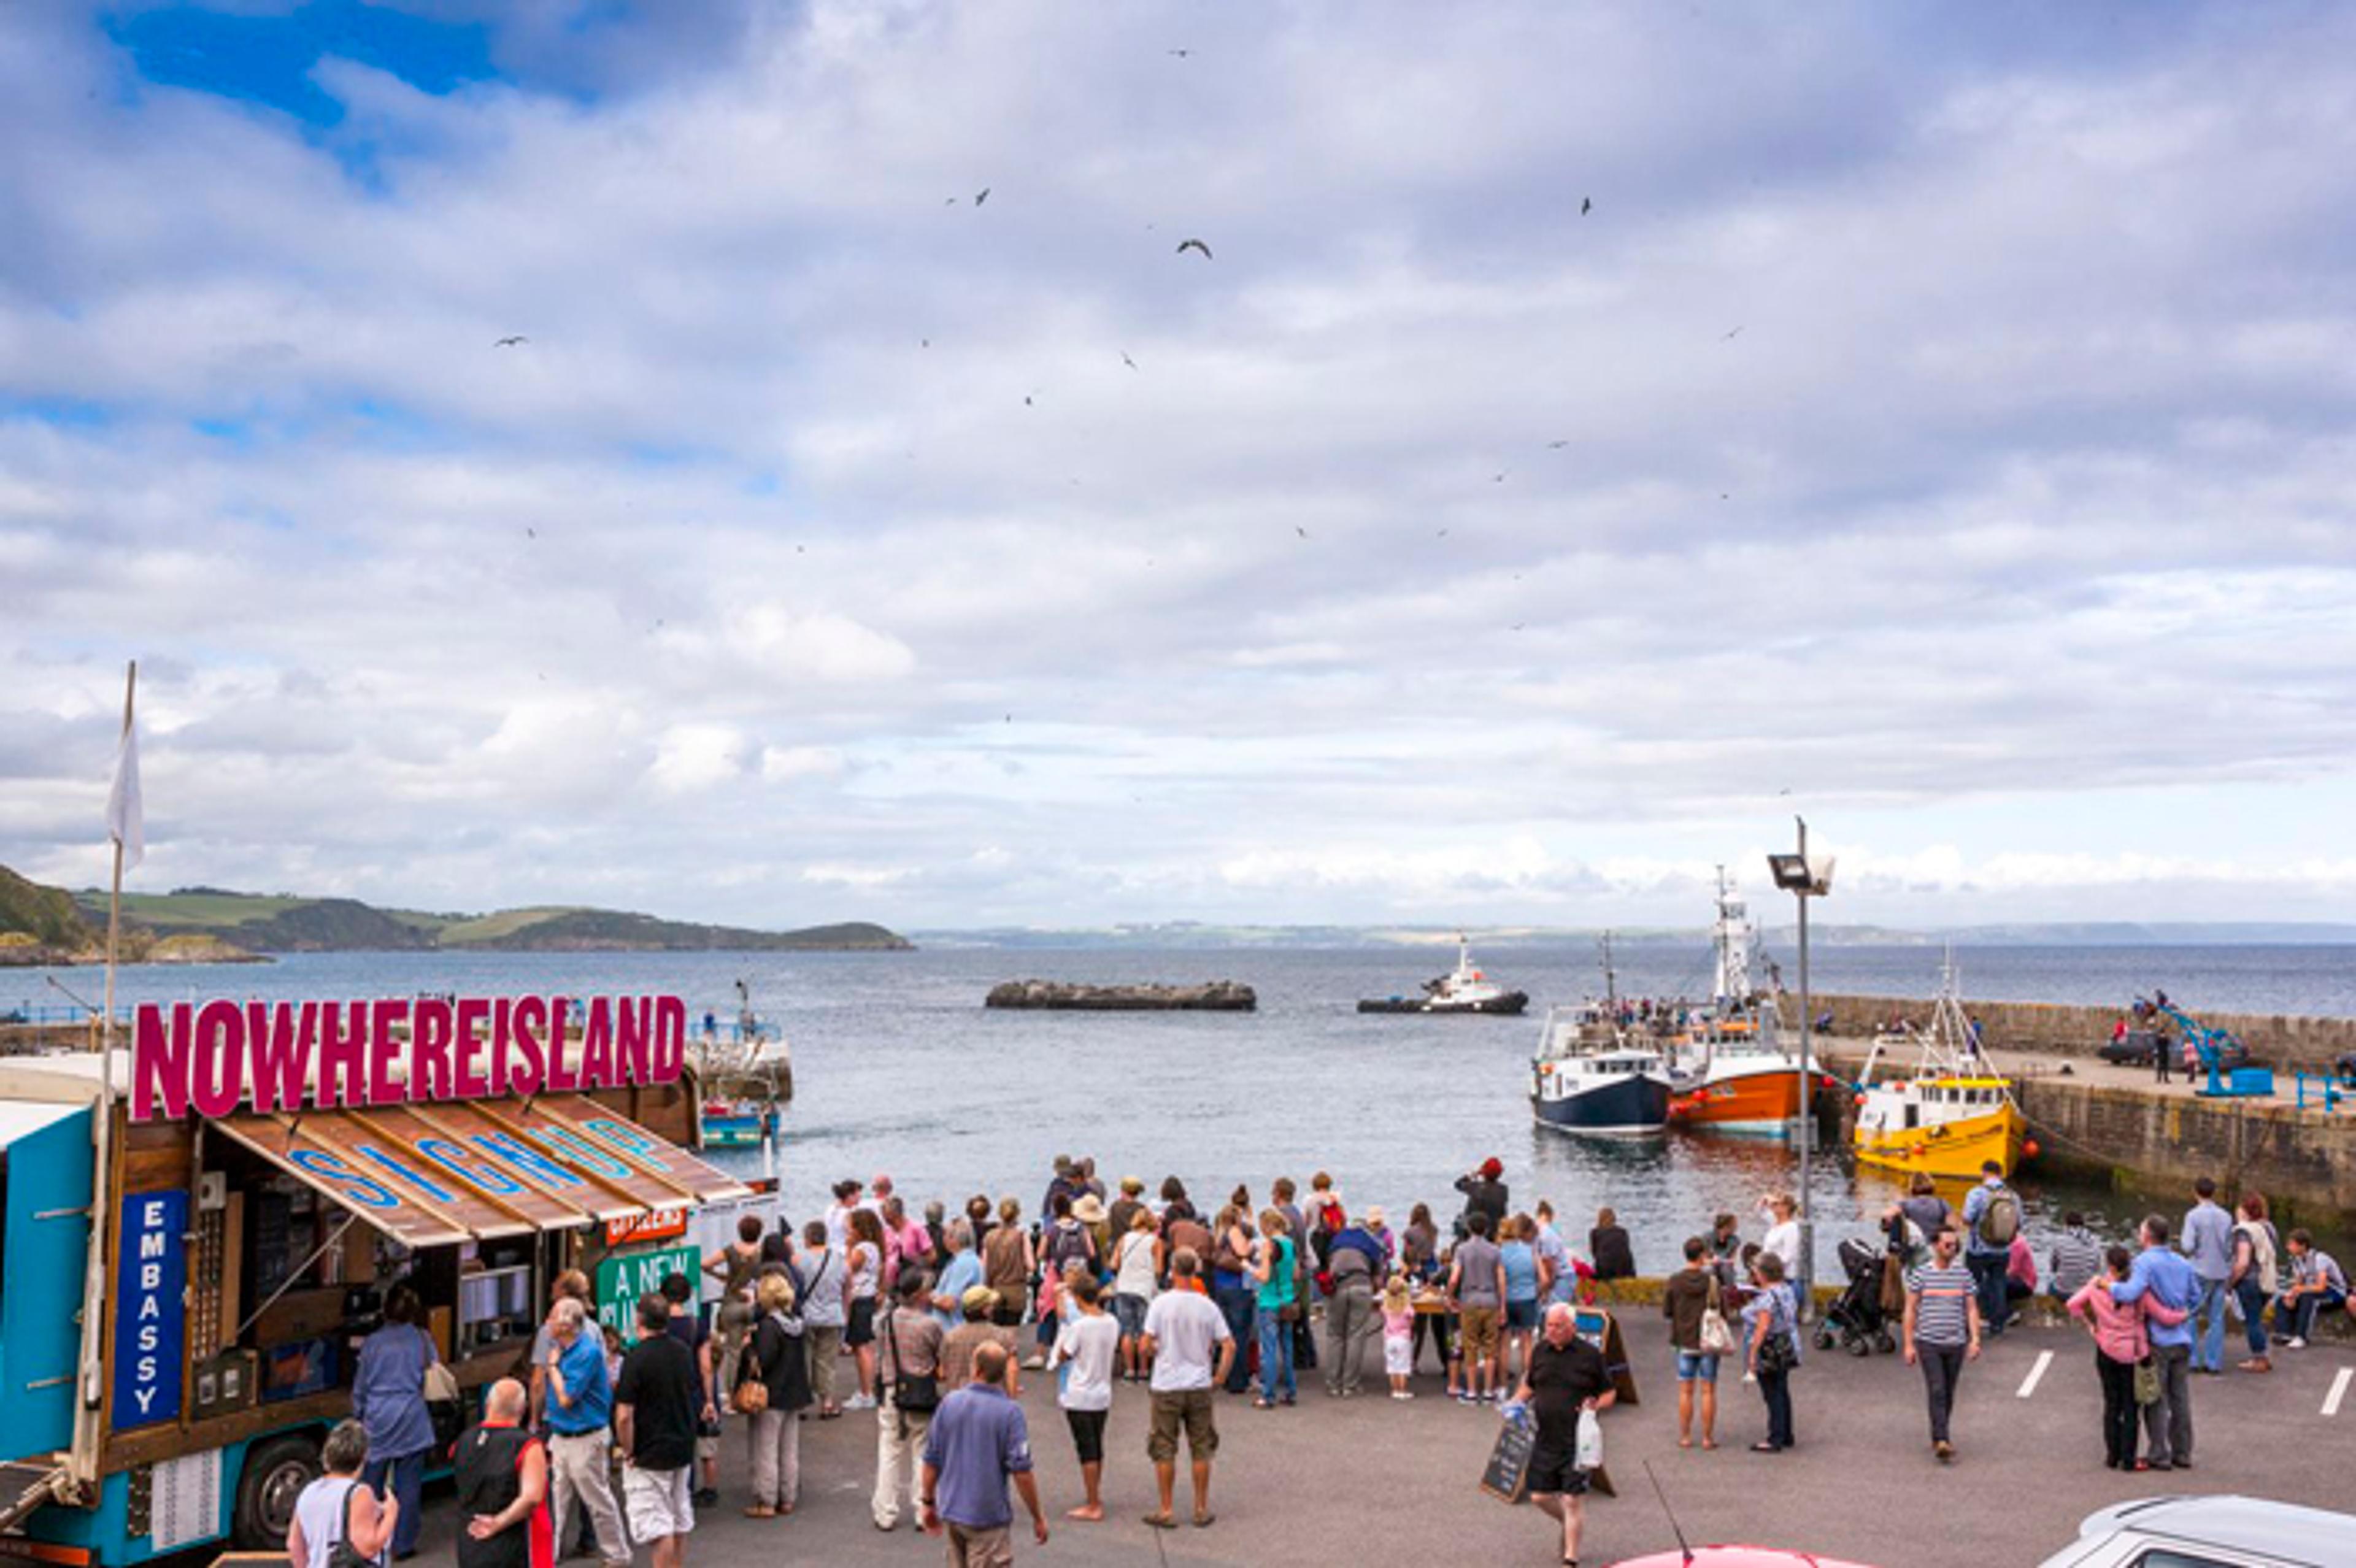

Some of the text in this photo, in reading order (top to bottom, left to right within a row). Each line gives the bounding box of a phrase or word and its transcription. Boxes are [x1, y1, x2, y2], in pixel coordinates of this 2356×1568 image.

[128, 994, 686, 1123] NOWHEREISLAND
[288, 1117, 672, 1208] SIGN UP
[134, 1201, 166, 1415] EMBASSY
[616, 1251, 689, 1297] A NEW
